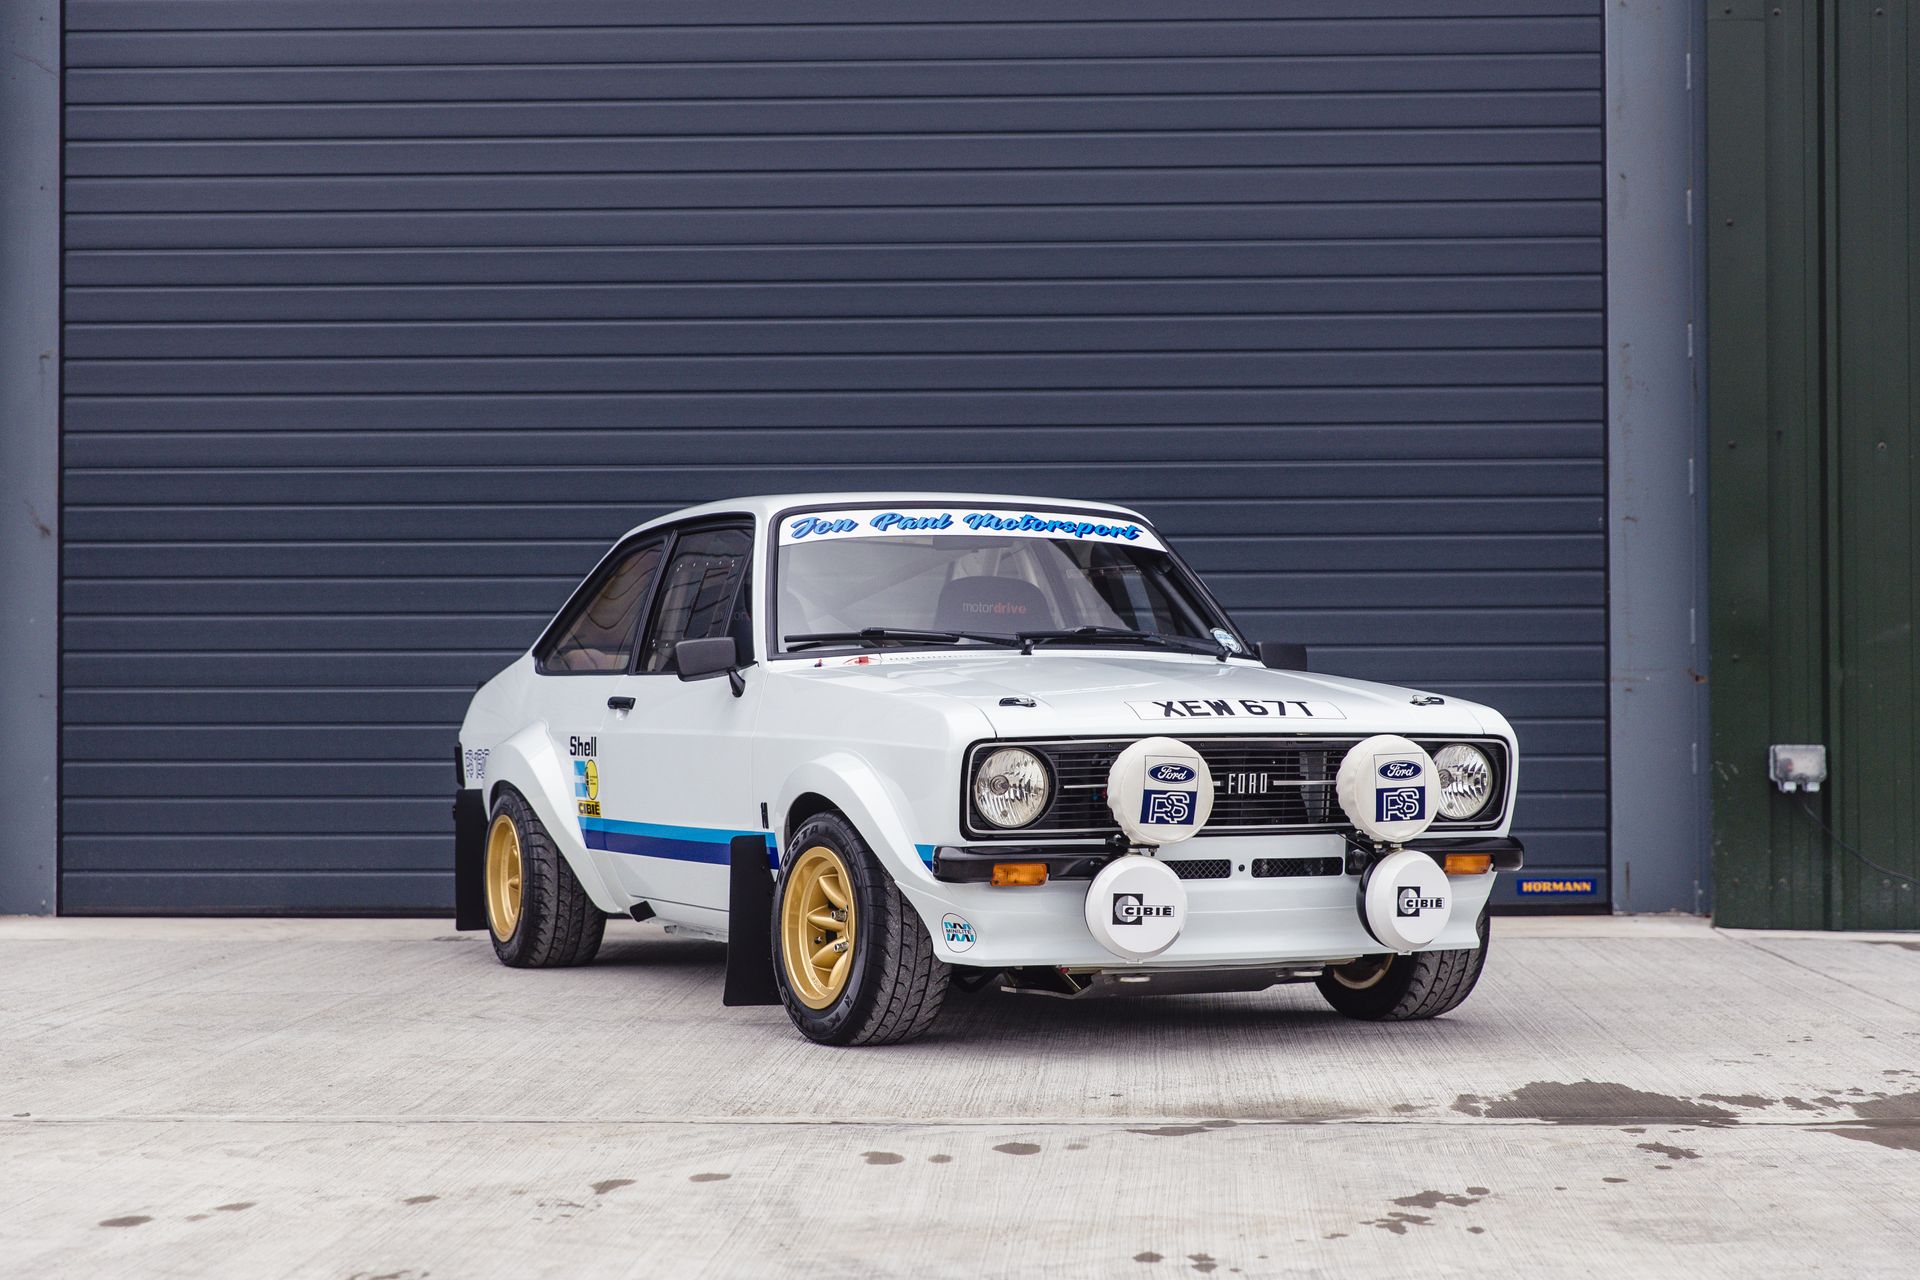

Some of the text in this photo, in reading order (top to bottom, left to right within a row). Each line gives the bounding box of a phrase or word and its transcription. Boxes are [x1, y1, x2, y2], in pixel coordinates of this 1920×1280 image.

[790, 511, 1144, 540] Jon Paul Motorsport
[962, 601, 1027, 614] motordrive
[1151, 699, 1314, 718] XEW 67T
[569, 735, 597, 757] Shell
[1157, 765, 1188, 781] Ford
[1387, 763, 1415, 777] Ford
[1228, 772, 1268, 794] FORD
[1148, 791, 1190, 824] RS
[1383, 788, 1420, 821] RS
